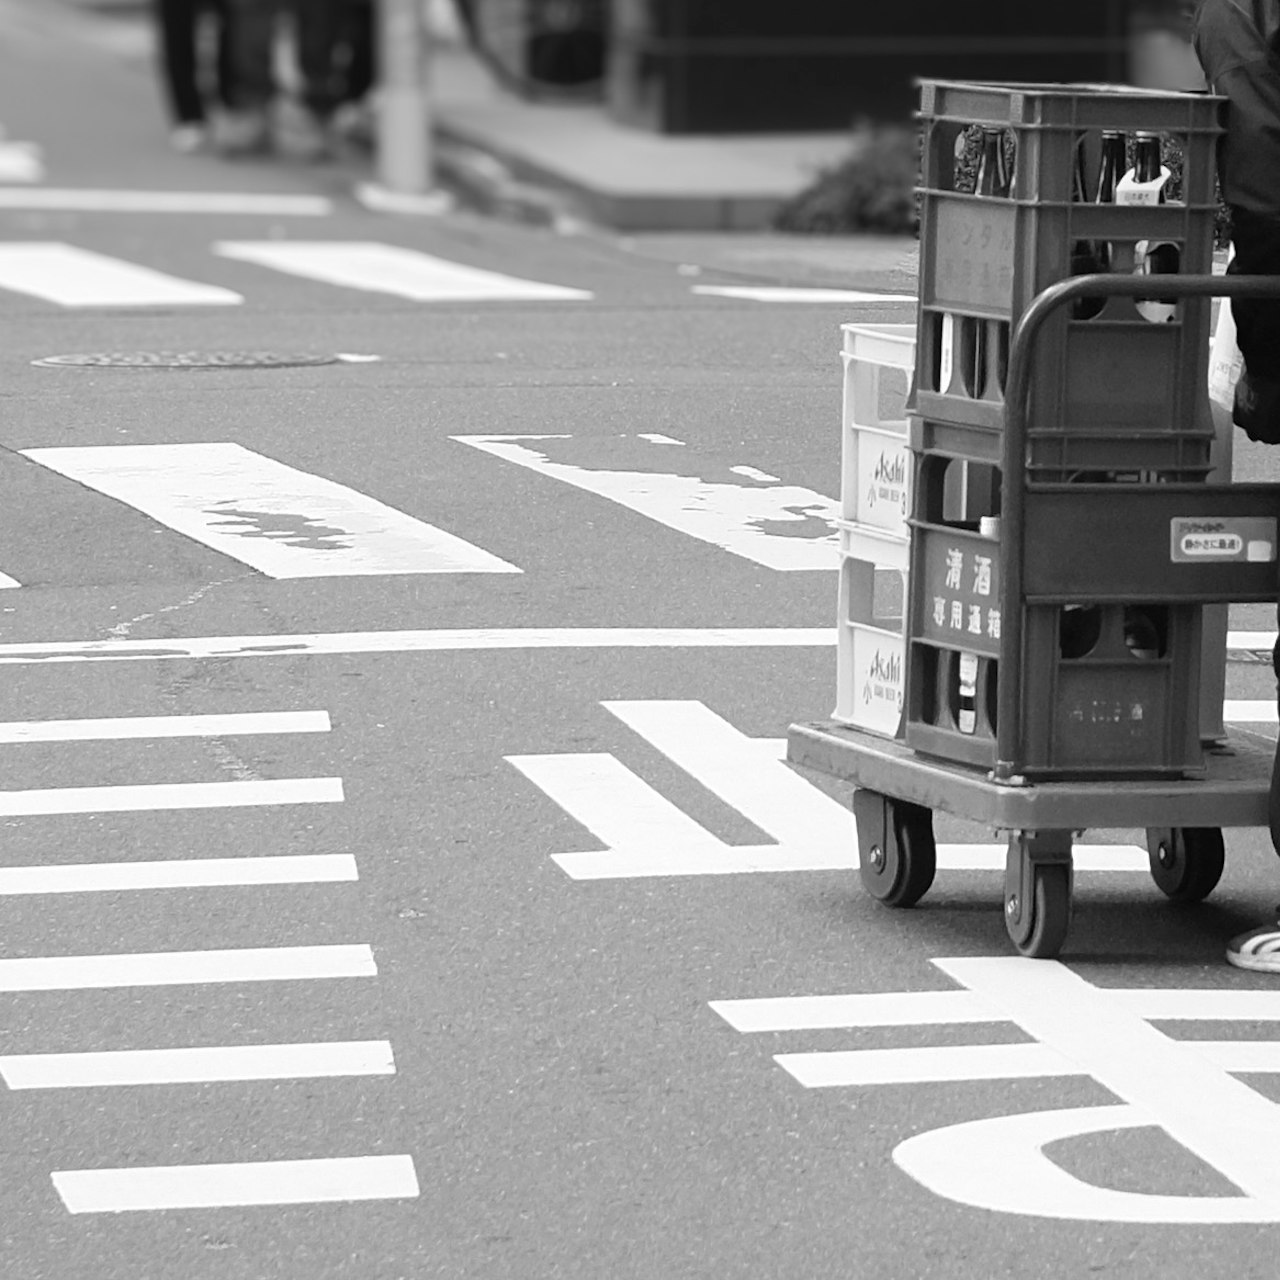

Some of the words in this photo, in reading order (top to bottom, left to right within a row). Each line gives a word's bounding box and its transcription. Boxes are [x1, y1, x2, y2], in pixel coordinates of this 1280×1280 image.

[945, 548, 993, 596] 清酒
[933, 596, 1001, 639] 専用通箱
